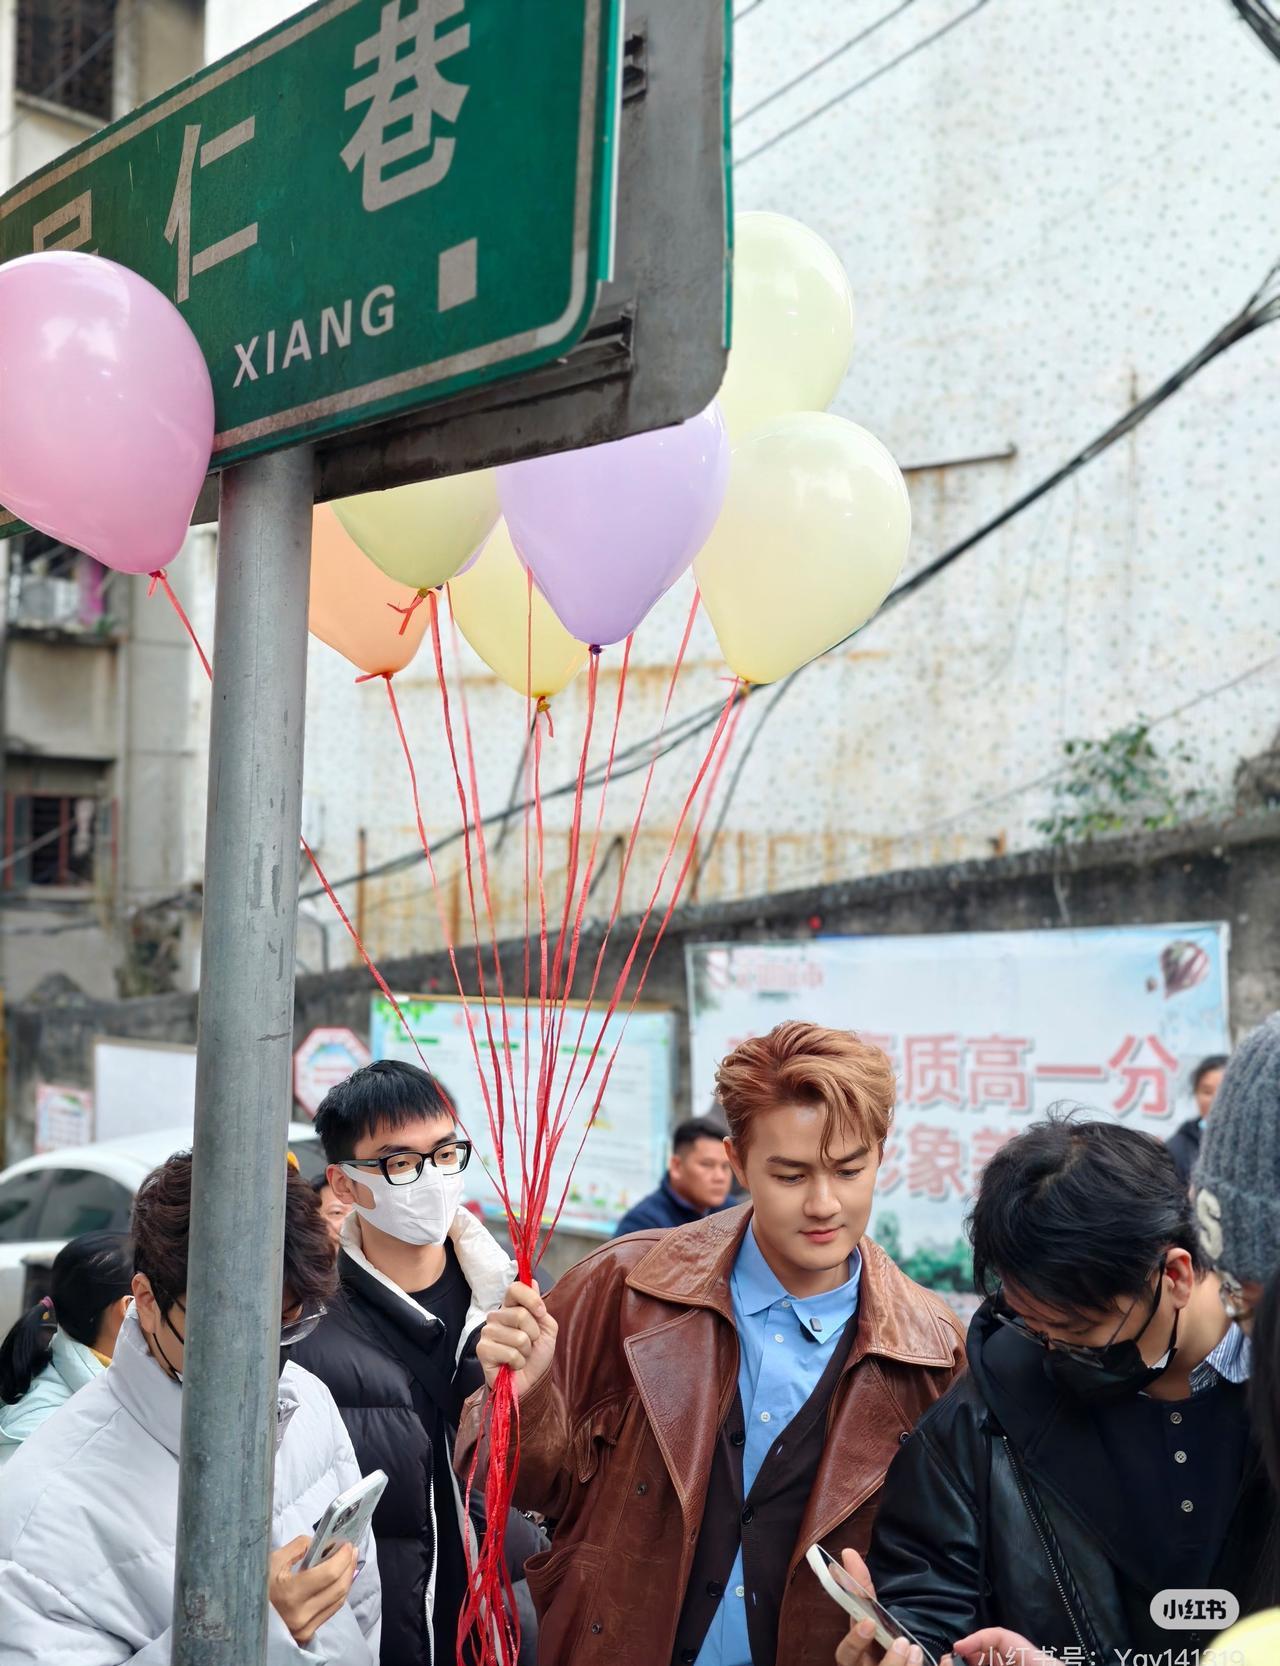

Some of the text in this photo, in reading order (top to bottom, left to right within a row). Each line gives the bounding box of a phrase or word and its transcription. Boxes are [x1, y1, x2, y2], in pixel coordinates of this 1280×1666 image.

[32, 0, 470, 303] 仁巷
[232, 284, 395, 388] XIANG
[856, 1031, 1179, 1114] 质高一分
